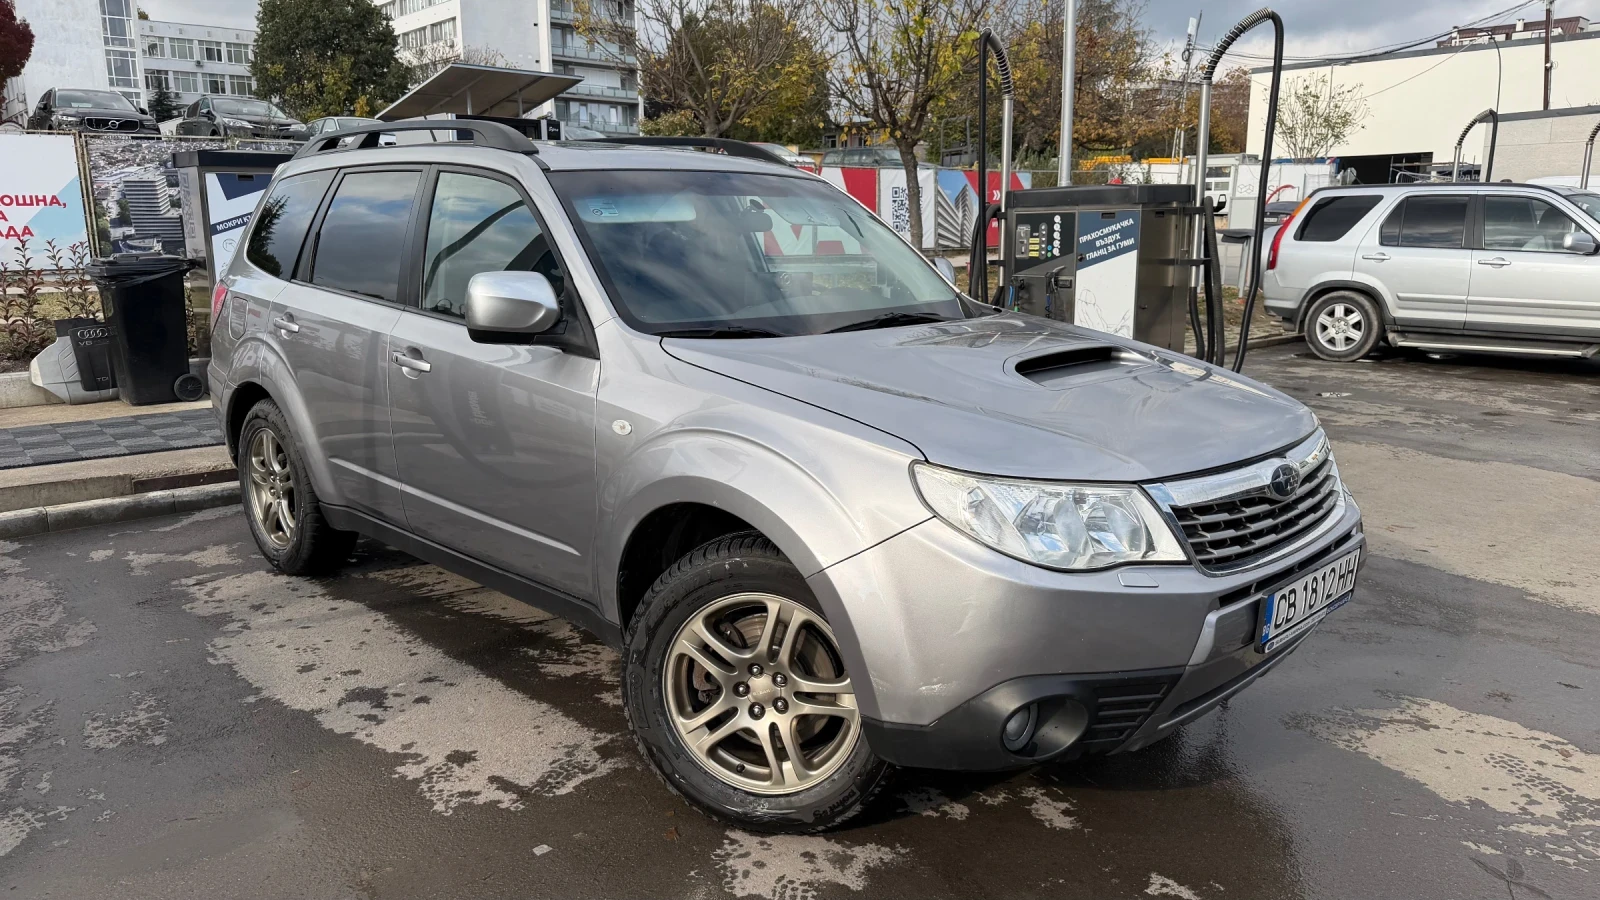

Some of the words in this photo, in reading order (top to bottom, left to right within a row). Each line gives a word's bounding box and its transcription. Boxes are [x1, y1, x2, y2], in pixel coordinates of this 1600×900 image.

[0, 194, 67, 209] ОШНА,
[216, 217, 243, 232] МОКРИ
[1079, 218, 1134, 243] ПРАХОСМУКАЧКА
[1086, 247, 1108, 260] ГЛАНЦ
[1106, 244, 1116, 253] ЗА
[1115, 237, 1135, 249] ГУМИ
[1095, 232, 1121, 247] ВЪЗДУХ
[1273, 587, 1297, 630] CB
